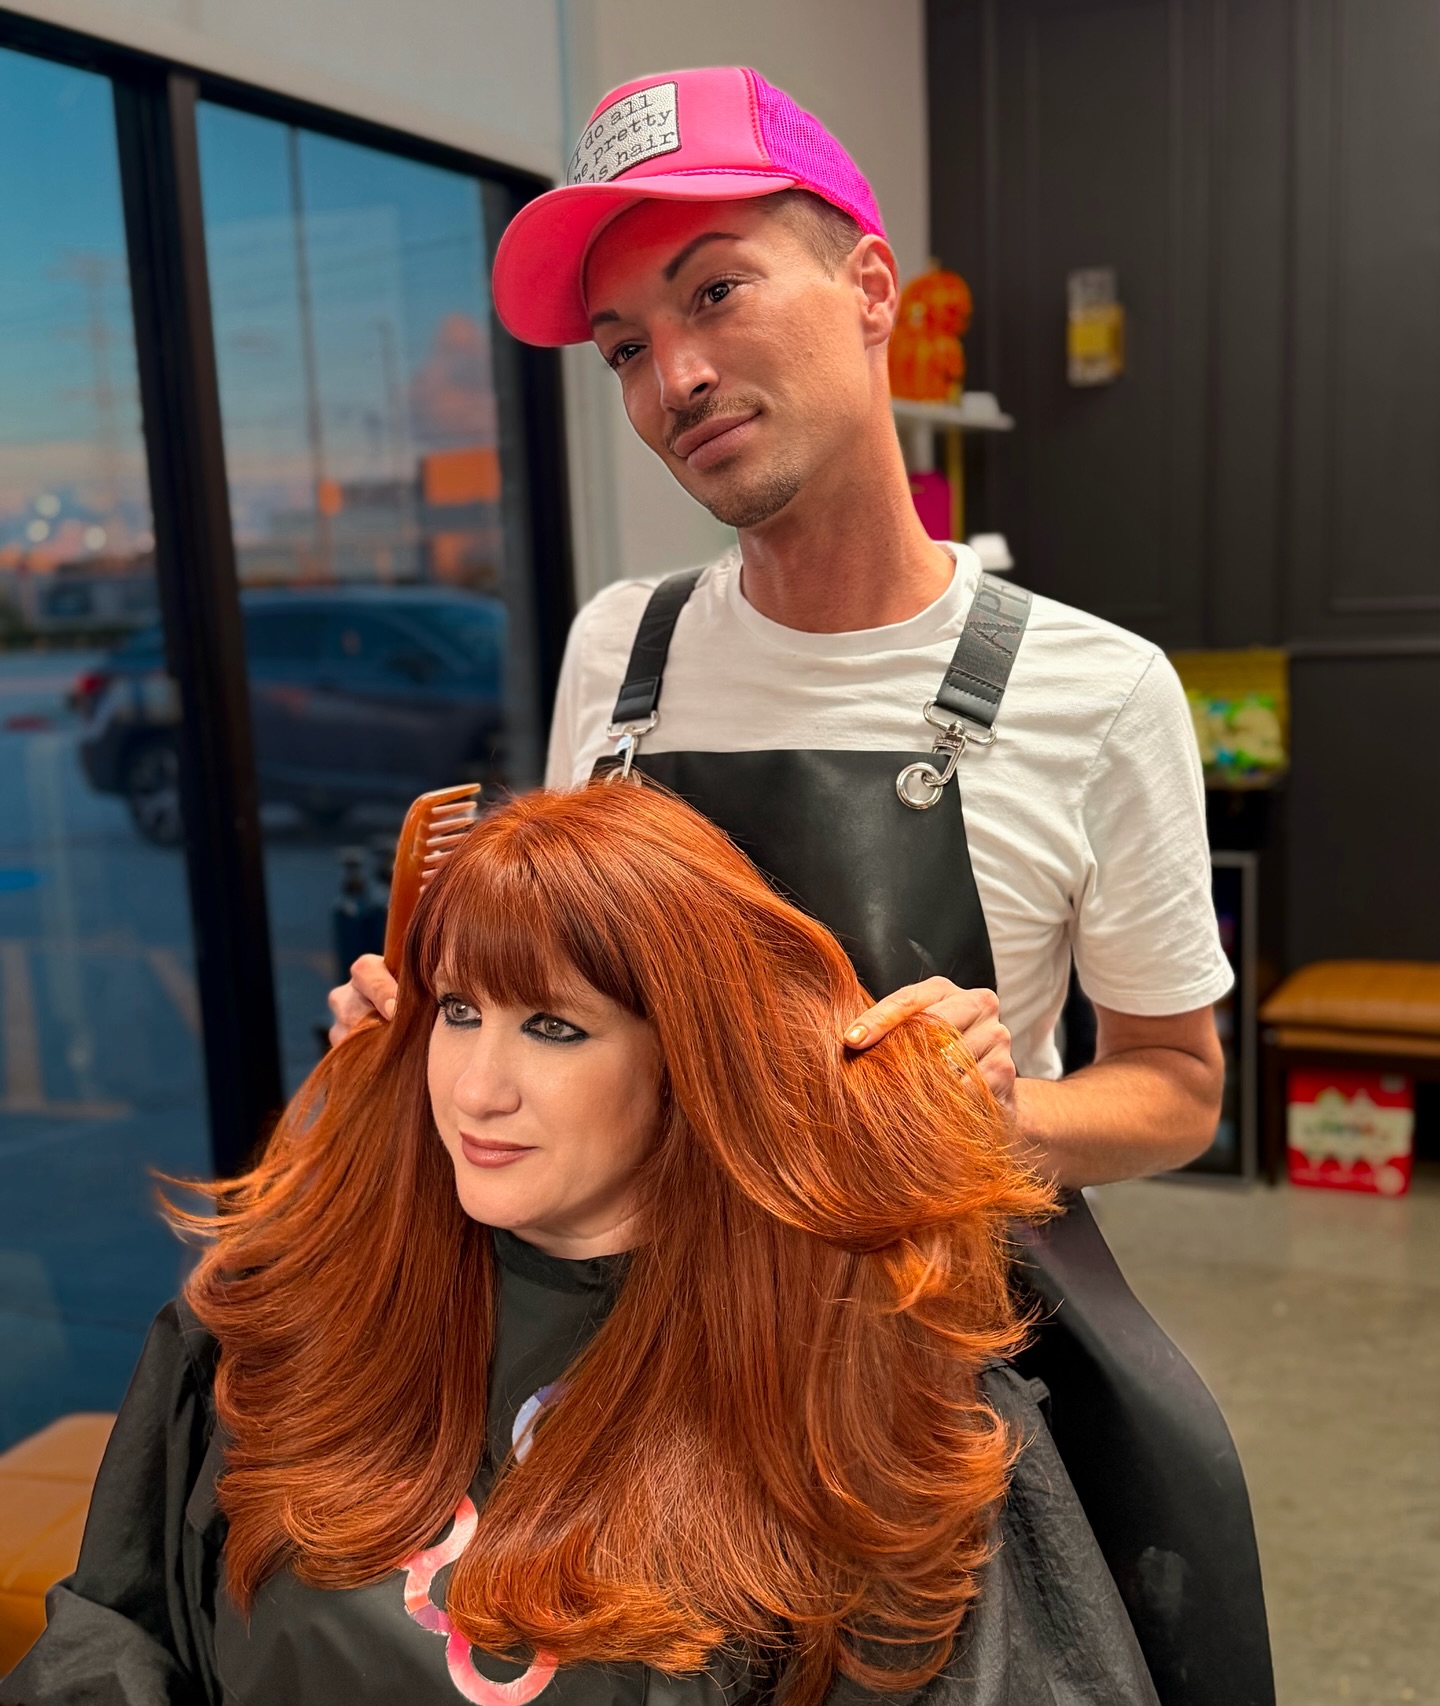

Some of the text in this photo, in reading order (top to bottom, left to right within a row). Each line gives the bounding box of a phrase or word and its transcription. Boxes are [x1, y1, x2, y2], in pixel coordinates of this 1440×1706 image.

[584, 124, 604, 150] do
[610, 94, 654, 126] all
[593, 108, 674, 168] pretty
[614, 131, 675, 168] hair
